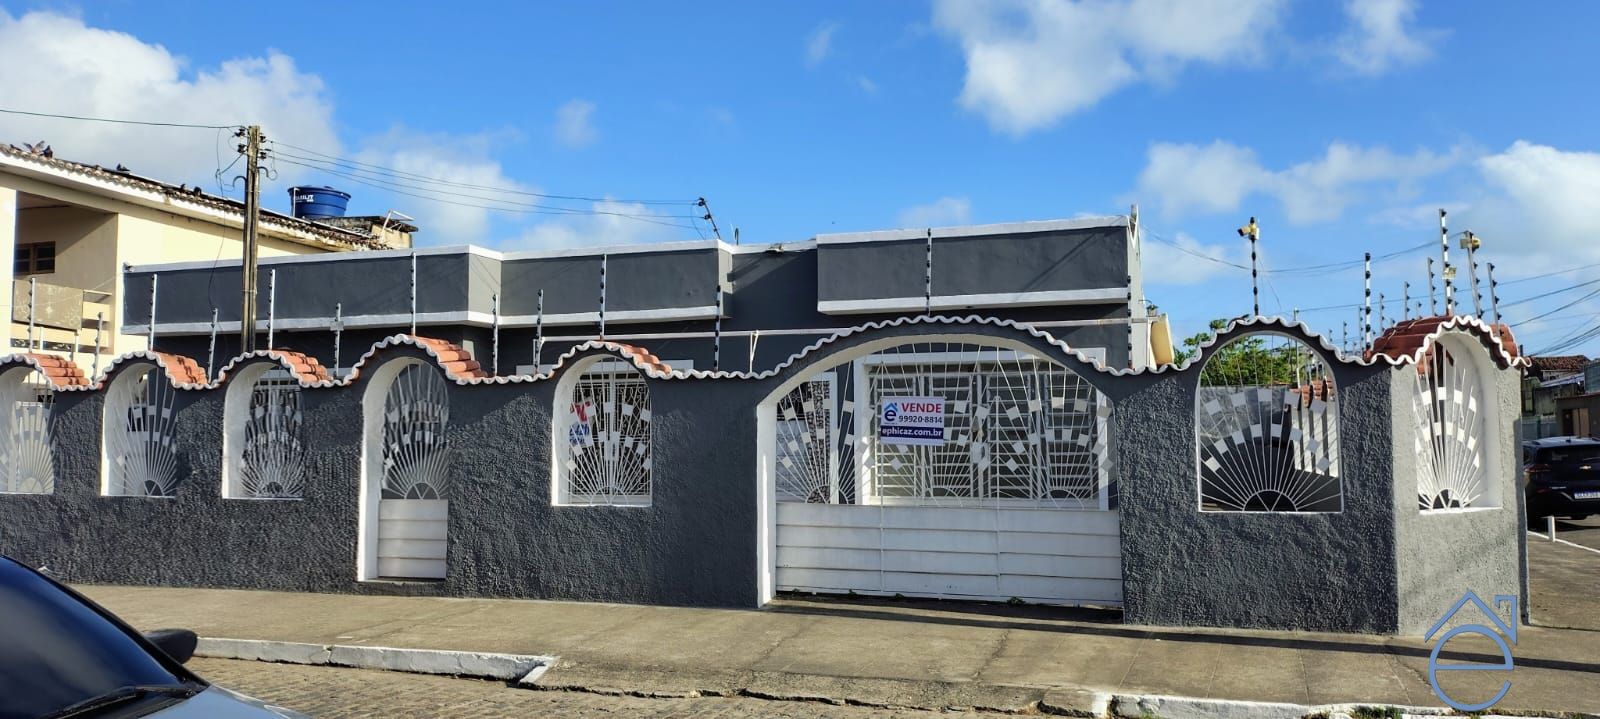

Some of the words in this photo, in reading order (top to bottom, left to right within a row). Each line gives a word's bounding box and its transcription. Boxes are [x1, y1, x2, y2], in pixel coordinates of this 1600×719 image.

[901, 402, 942, 413] VENDE
[898, 415, 943, 424] 99920-8814
[881, 426, 943, 437] ephicaz.com.br
